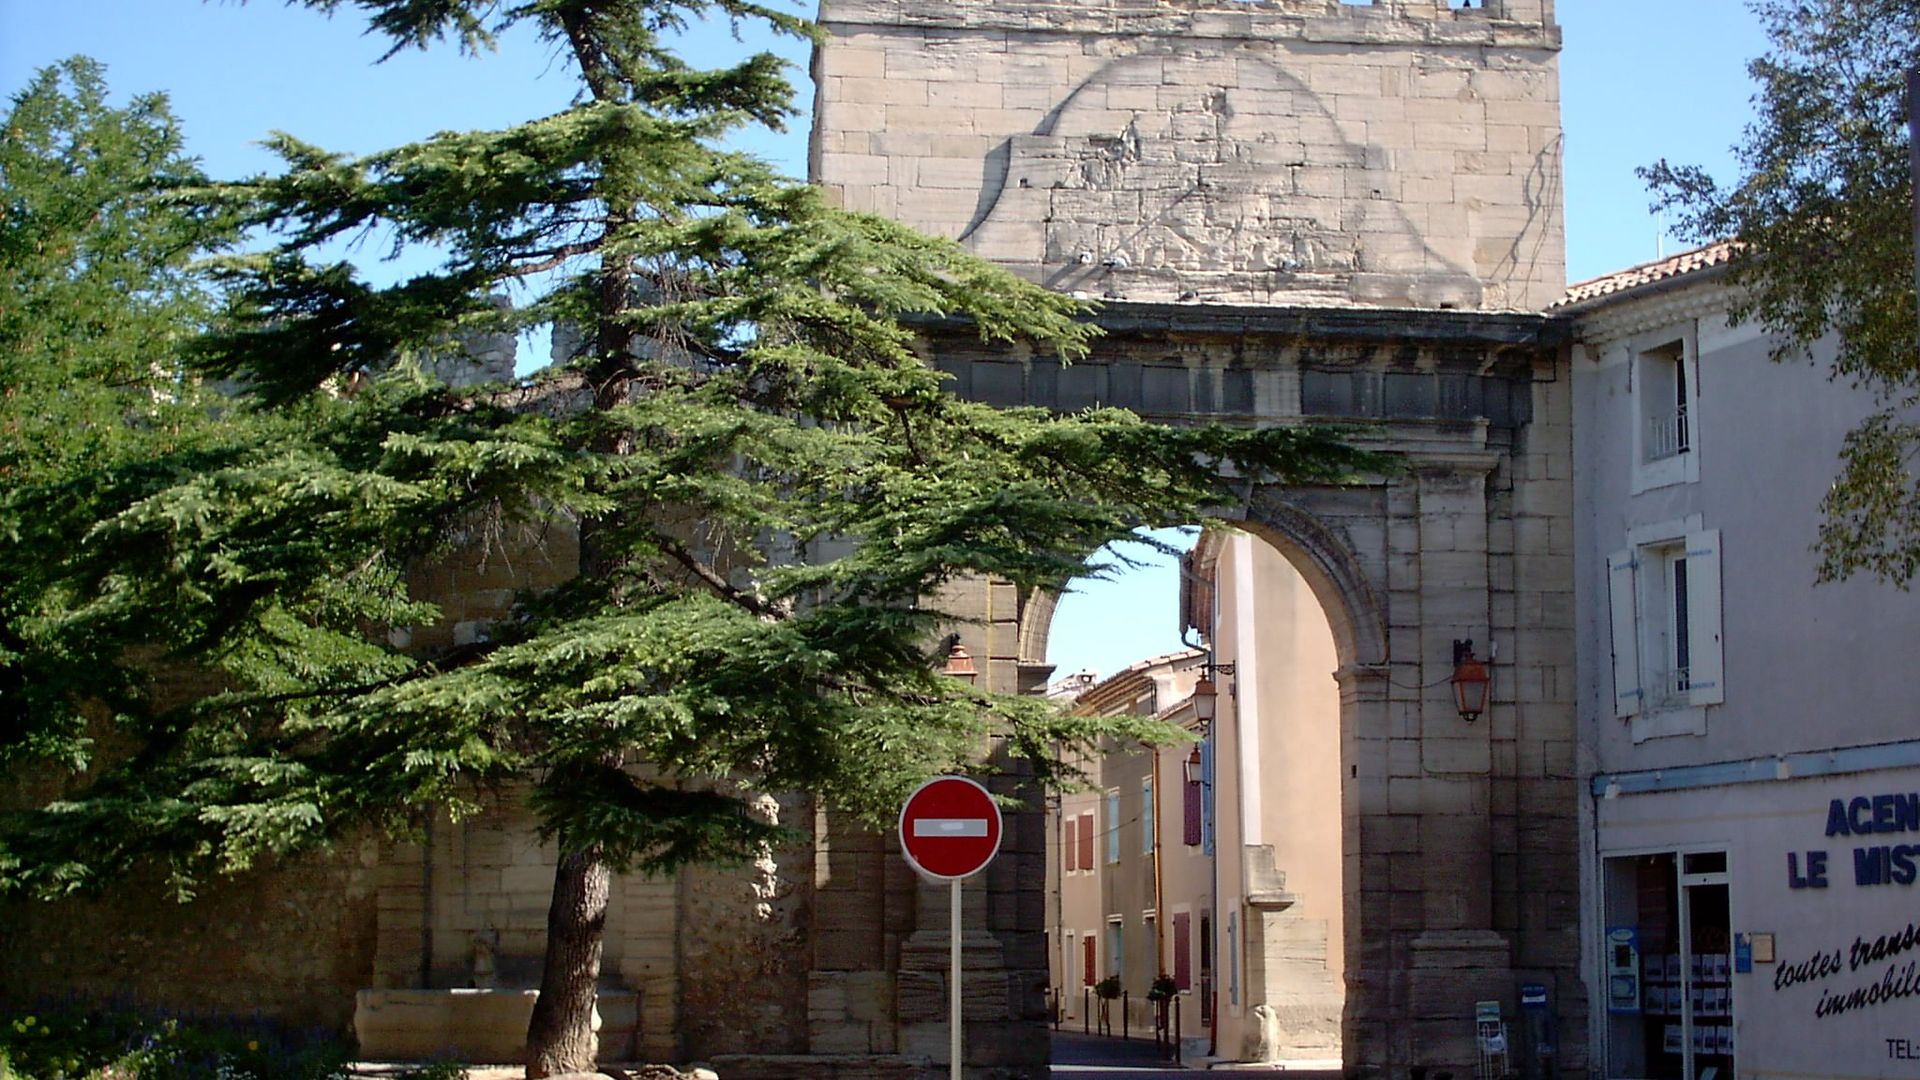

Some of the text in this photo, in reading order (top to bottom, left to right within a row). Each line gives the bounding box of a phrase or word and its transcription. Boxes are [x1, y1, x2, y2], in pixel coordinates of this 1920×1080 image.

[1825, 793, 1920, 836] AGEN
[1787, 850, 1829, 888] LE
[1774, 949, 1842, 991] toutes
